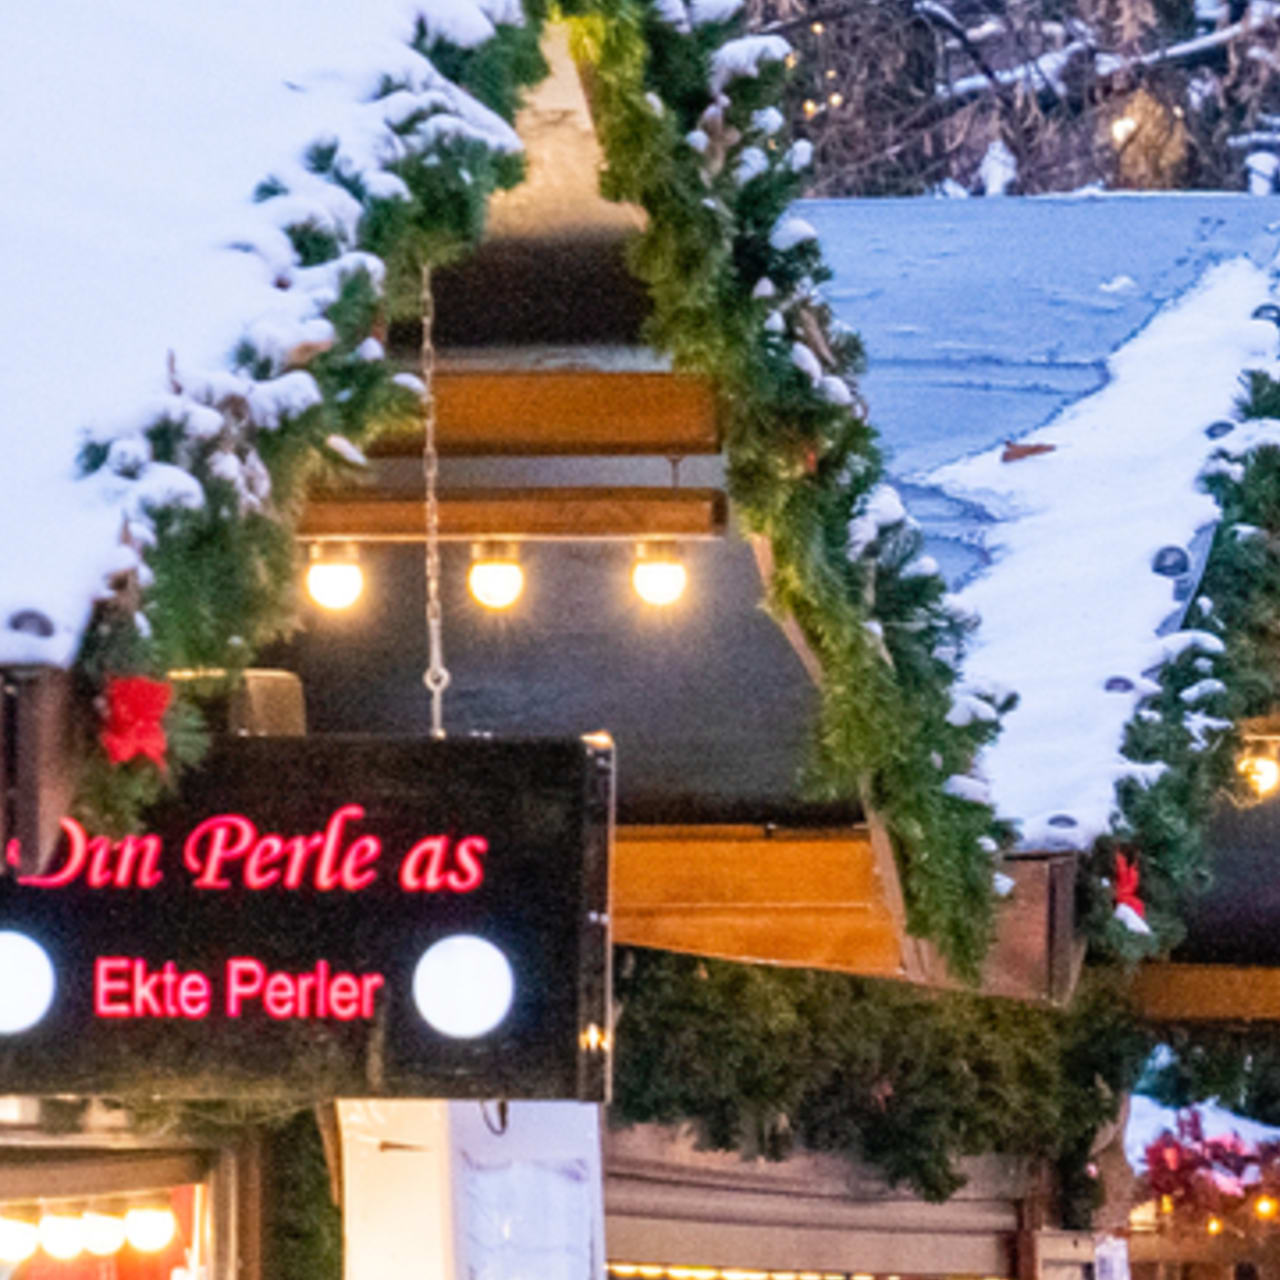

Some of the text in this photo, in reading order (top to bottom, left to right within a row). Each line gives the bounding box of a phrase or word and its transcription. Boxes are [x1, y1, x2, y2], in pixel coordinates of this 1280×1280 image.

[184, 804, 382, 892] Perle
[399, 834, 488, 893] as
[94, 956, 385, 1020] Ekte Perler
